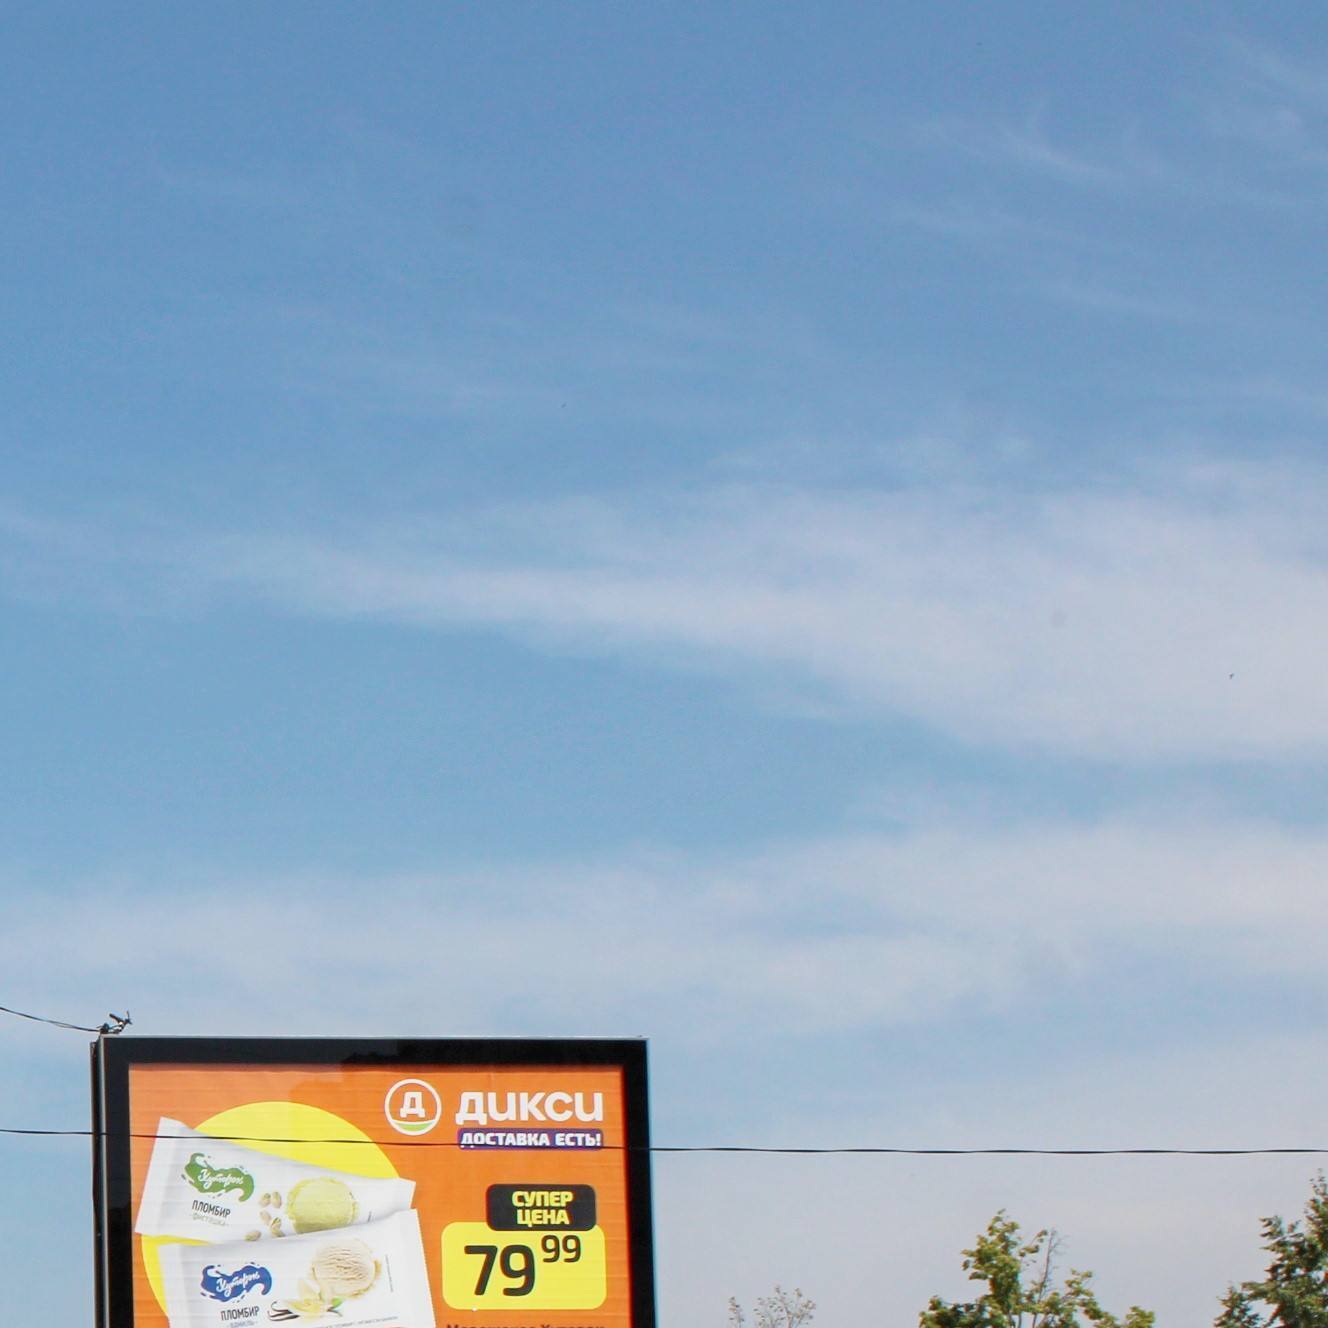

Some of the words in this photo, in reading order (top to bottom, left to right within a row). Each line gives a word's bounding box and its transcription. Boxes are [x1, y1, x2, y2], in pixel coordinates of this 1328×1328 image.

[455, 1091, 603, 1125] ДИКСИ
[461, 1132, 550, 1148] ДОСТАВКА
[555, 1132, 602, 1147] ЕСТЬ!
[511, 1190, 574, 1207] СУПЕР
[191, 1199, 231, 1218] ПЛОМБИР
[516, 1209, 570, 1227] ЦЕНА
[463, 1244, 536, 1297] 79
[541, 1234, 582, 1263] 99
[220, 1305, 260, 1321] ПЛОМБИР
